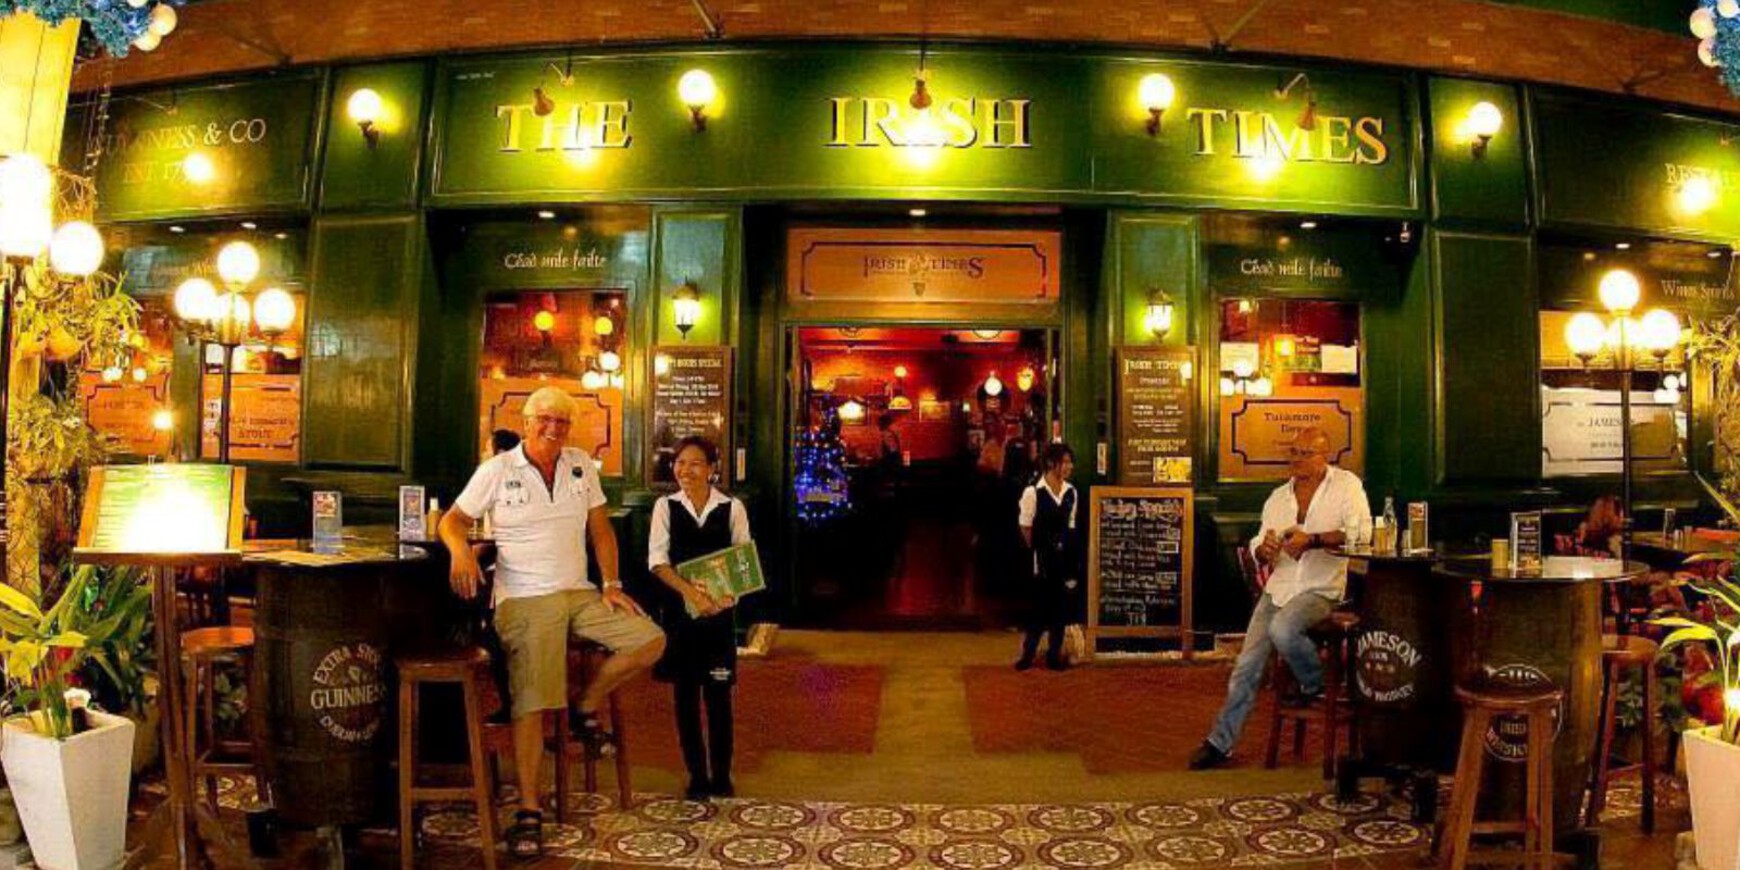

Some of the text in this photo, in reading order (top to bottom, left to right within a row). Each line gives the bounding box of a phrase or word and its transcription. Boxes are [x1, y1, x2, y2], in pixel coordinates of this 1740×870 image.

[203, 122, 222, 145] &
[229, 118, 266, 143] CO
[495, 100, 632, 152] THE
[1187, 107, 1387, 166] TIMES
[1586, 418, 1635, 428] JAMESN
[312, 645, 354, 684] EXTRA
[1357, 630, 1421, 668] JAMESON
